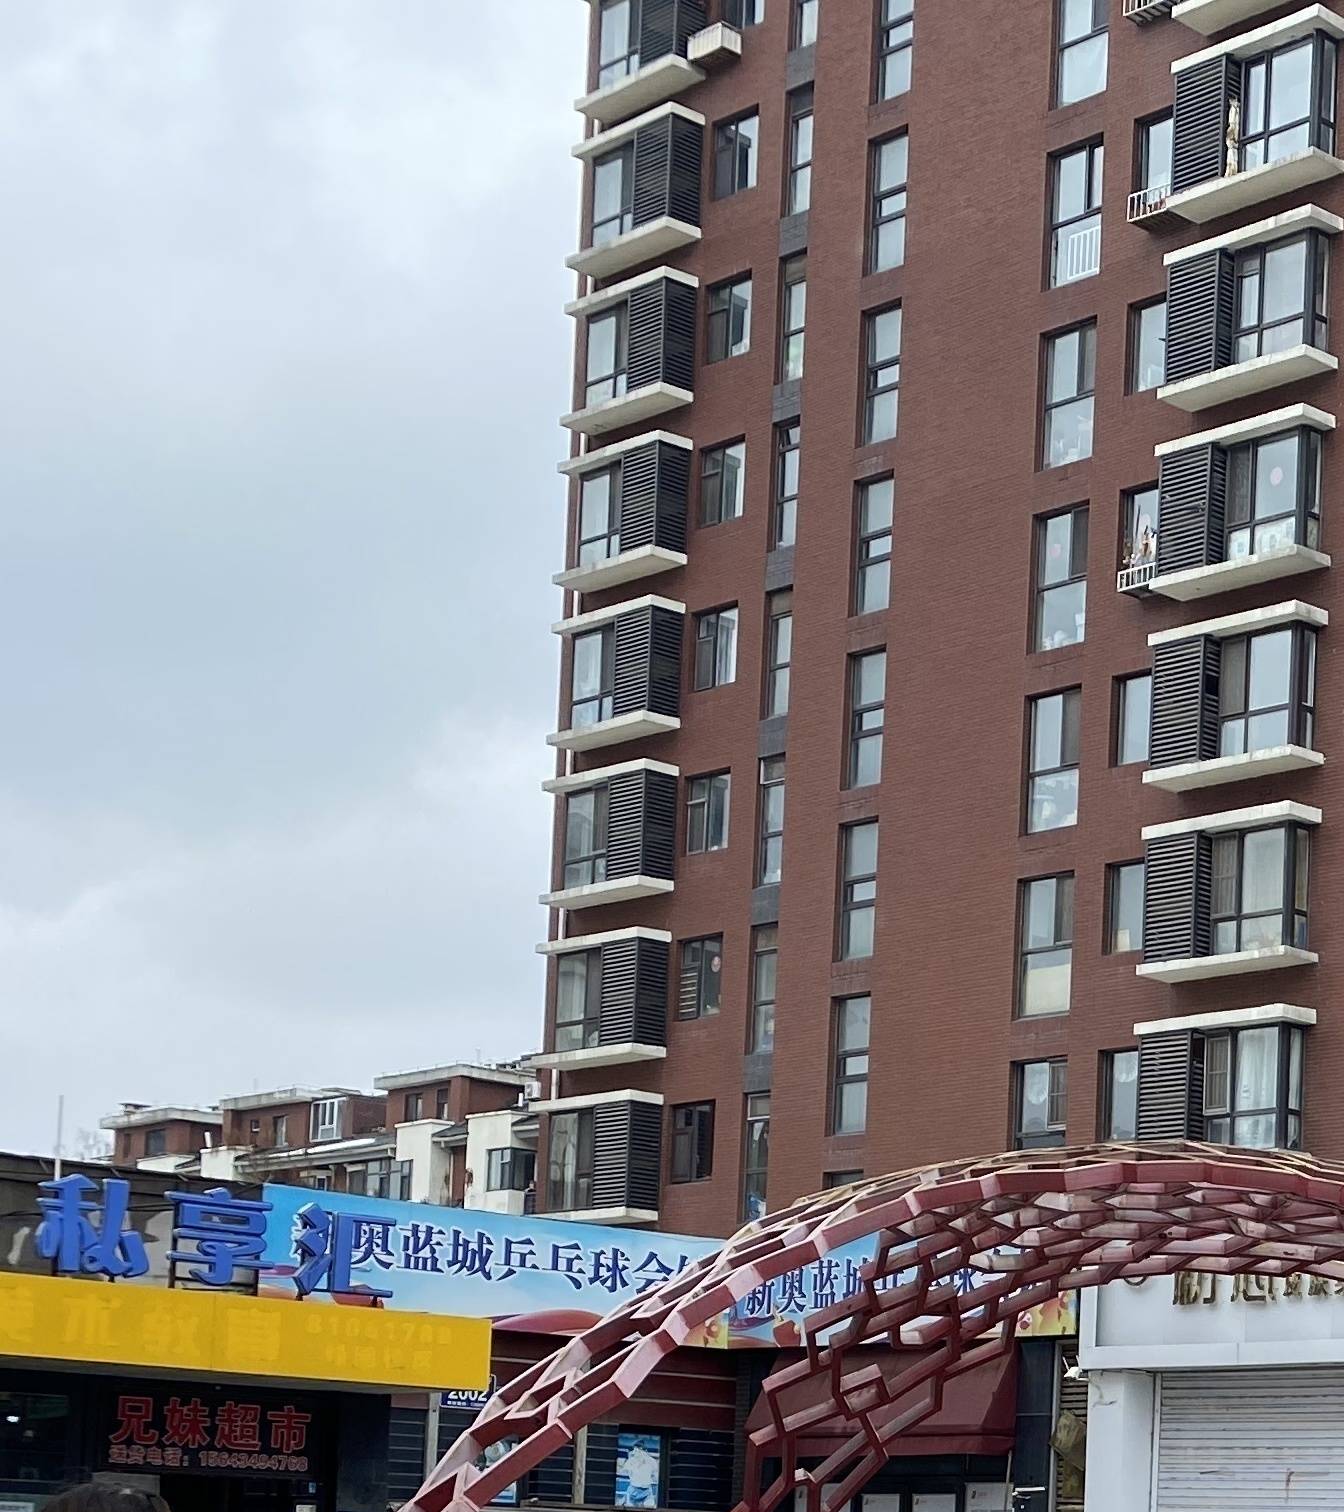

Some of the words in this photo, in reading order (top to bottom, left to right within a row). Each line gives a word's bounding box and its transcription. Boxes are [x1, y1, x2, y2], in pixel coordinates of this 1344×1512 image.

[36, 1173, 397, 1298] 私享汇
[292, 1212, 693, 1294] 奥蓝城乒乓球会
[109, 1395, 312, 1454] 兄妹超市
